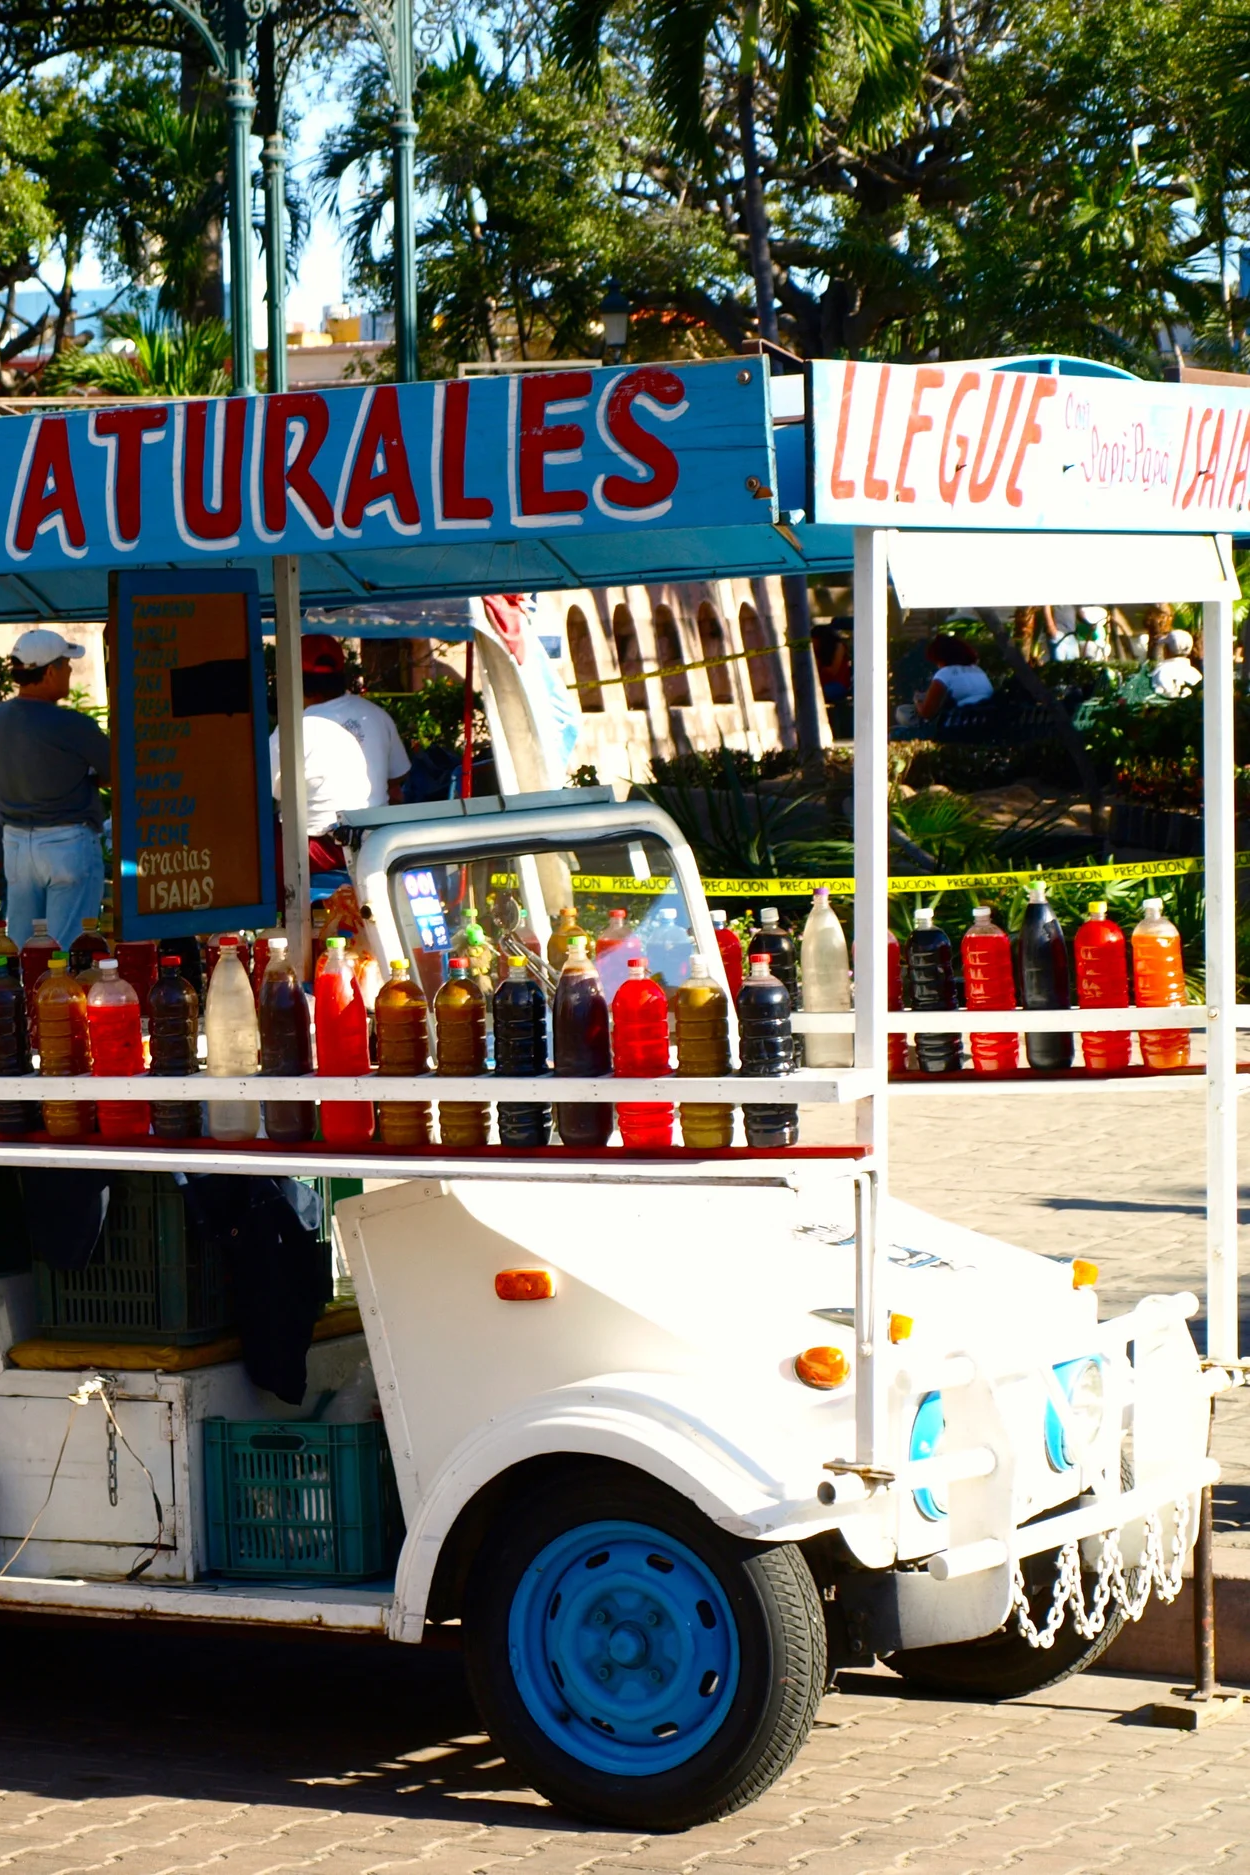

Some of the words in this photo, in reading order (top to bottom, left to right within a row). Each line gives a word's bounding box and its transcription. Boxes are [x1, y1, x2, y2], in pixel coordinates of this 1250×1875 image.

[829, 361, 1058, 508] LLEGUE
[1172, 406, 1250, 513] ISAIA
[136, 822, 190, 848] LECHE
[138, 844, 211, 878] Gracias
[888, 879, 936, 892] AUCION
[946, 874, 1019, 890] PRECAUCION
[1113, 859, 1187, 877] PRECAUCION
[149, 876, 215, 911] ISAIAS
